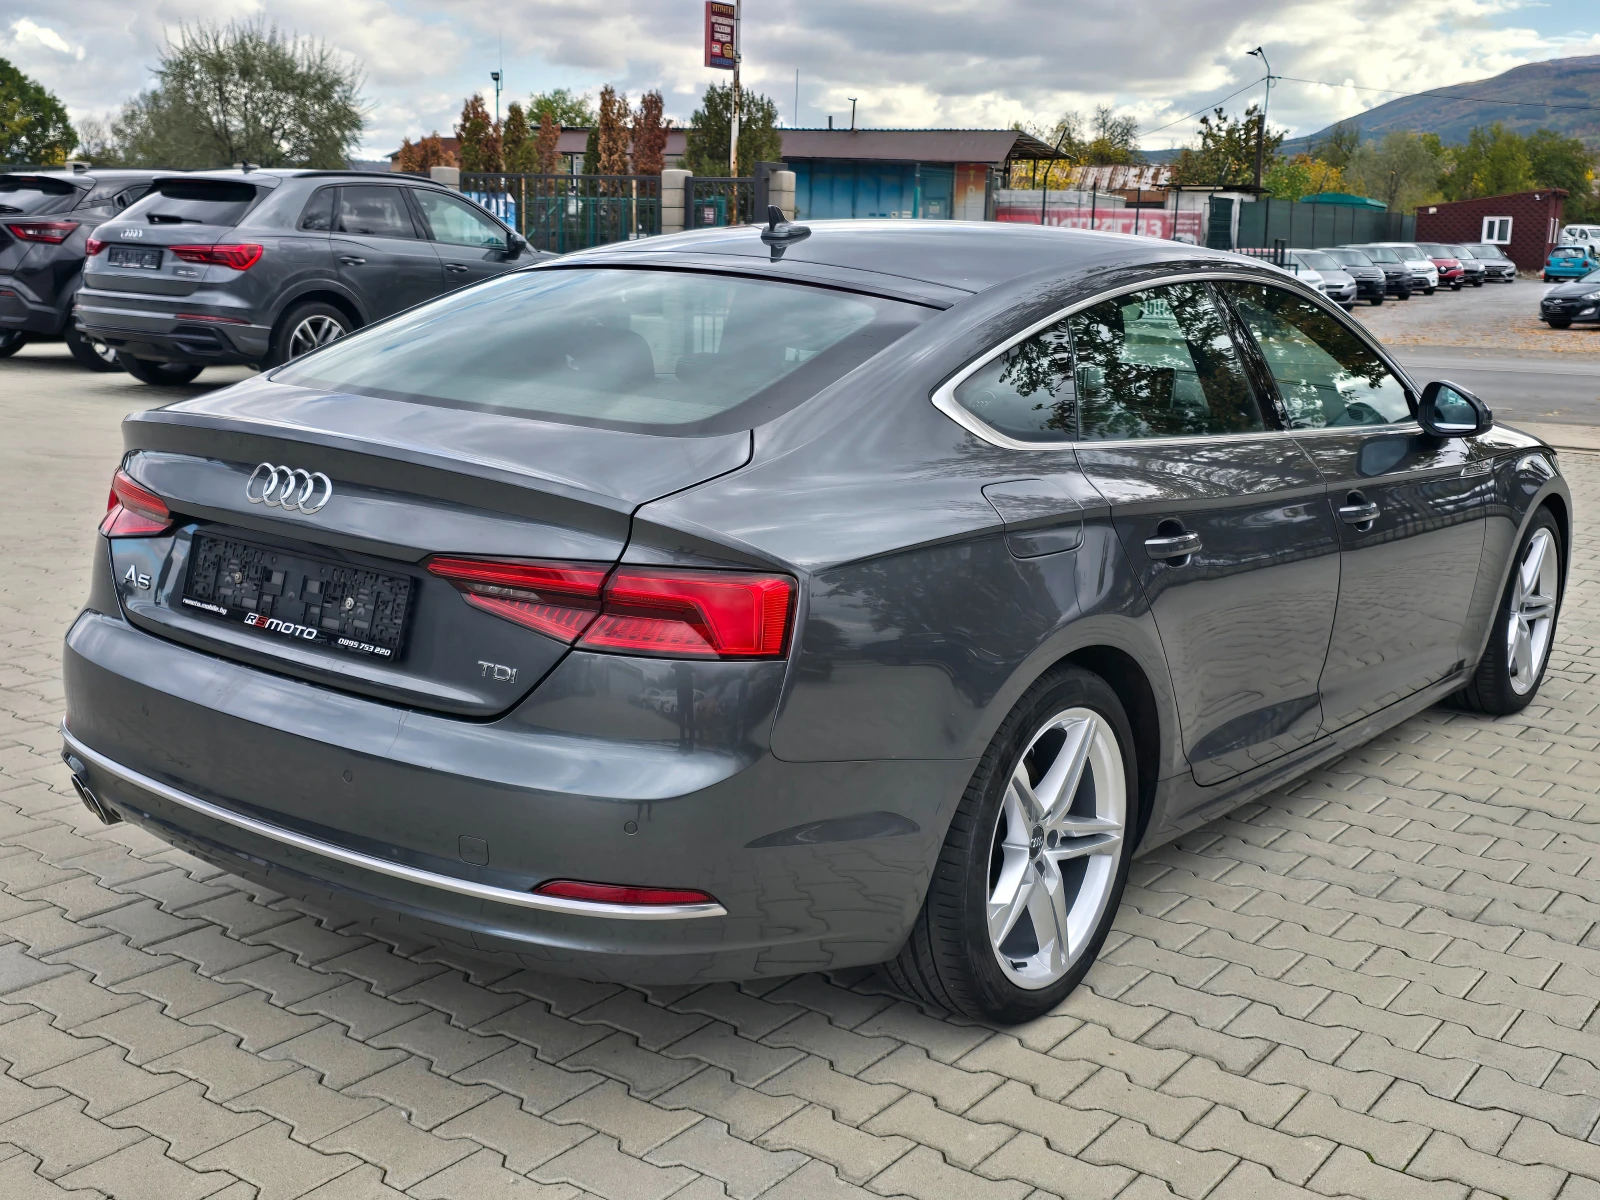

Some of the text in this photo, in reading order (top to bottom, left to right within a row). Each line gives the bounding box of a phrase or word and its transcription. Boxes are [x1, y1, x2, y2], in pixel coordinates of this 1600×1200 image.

[122, 564, 152, 591] A5
[244, 612, 317, 640] RSMOTO
[338, 637, 391, 656] 0895 753 220
[477, 660, 518, 684] TDI
